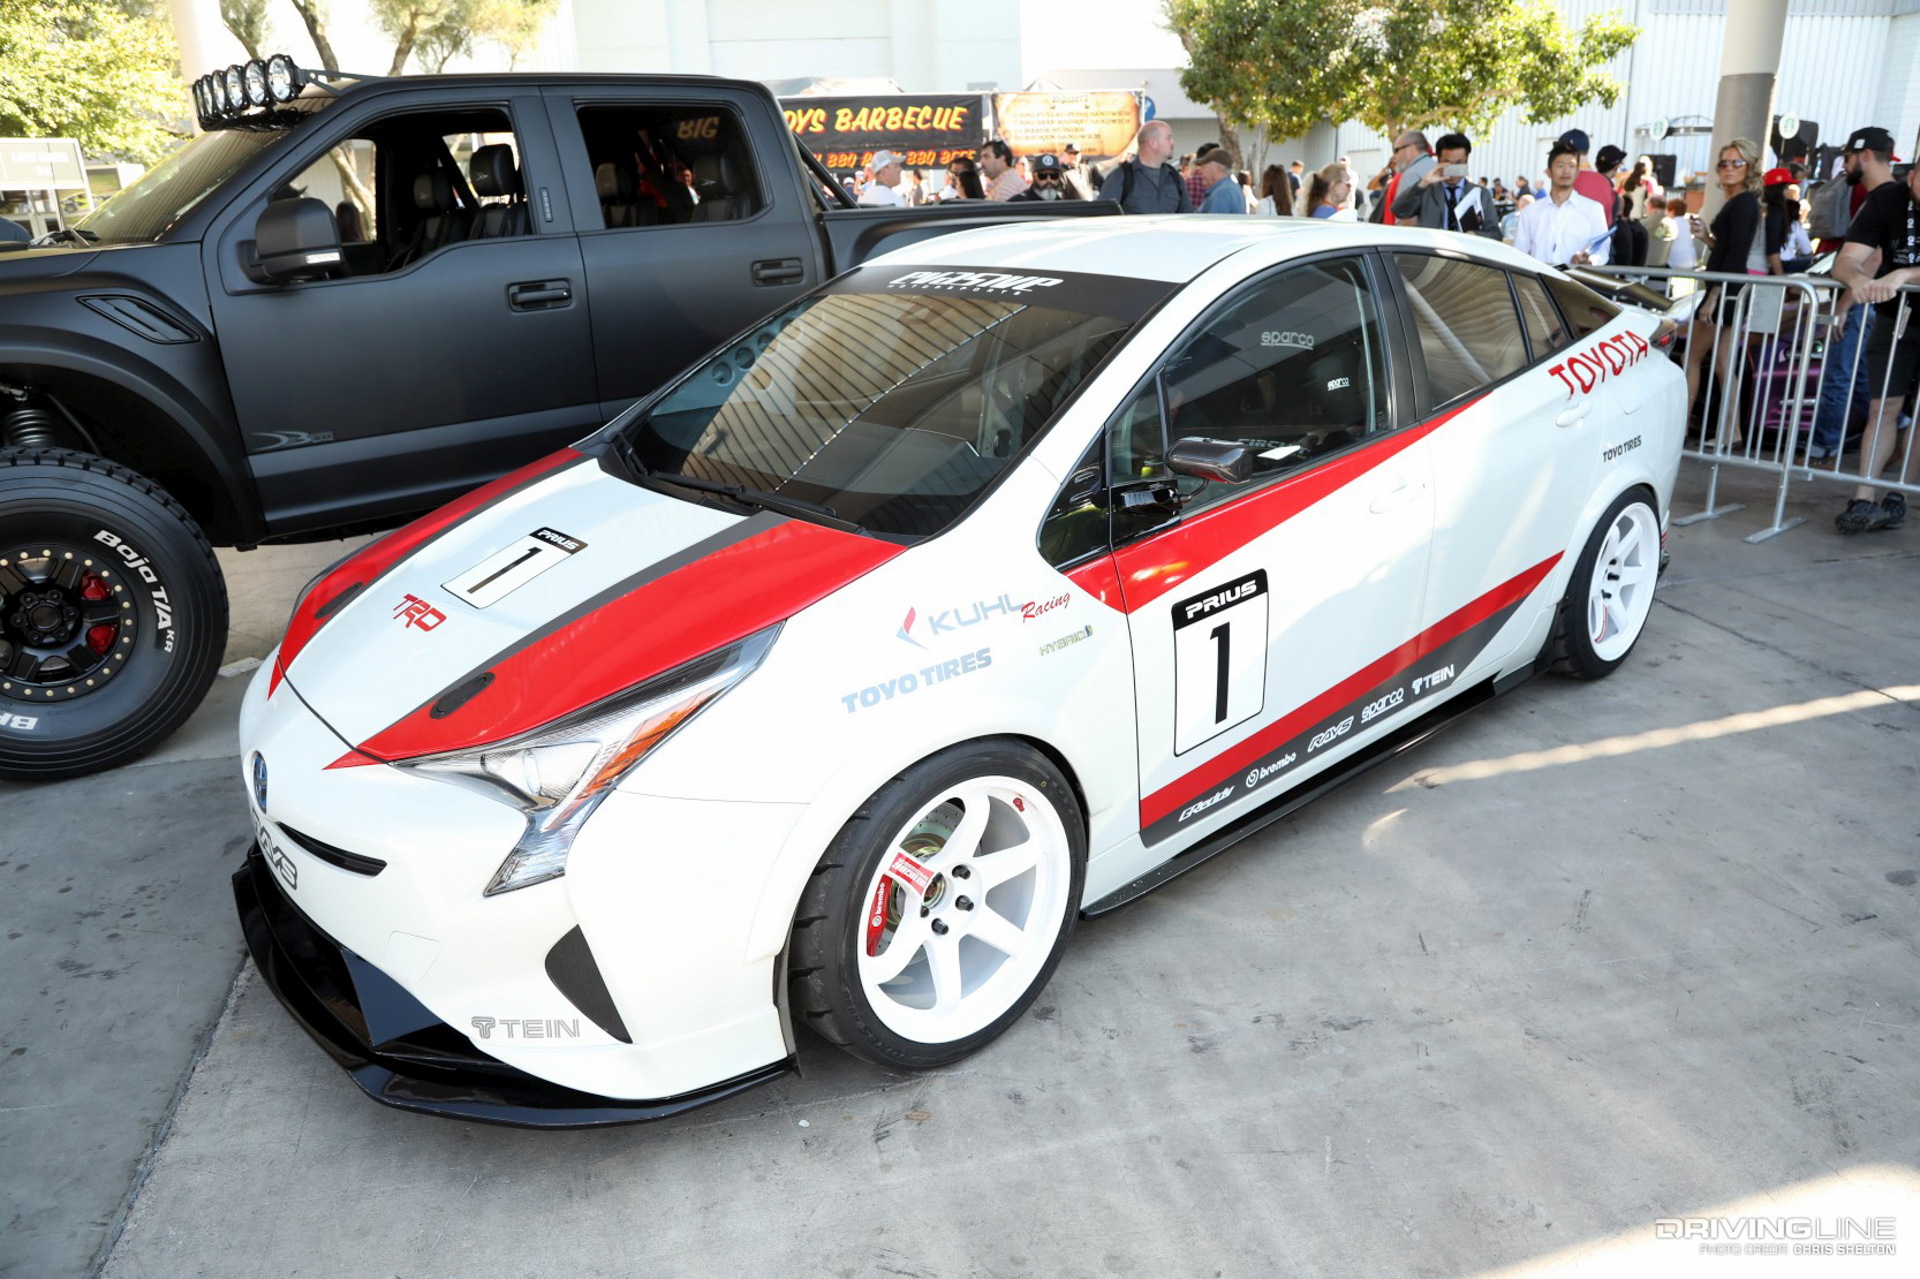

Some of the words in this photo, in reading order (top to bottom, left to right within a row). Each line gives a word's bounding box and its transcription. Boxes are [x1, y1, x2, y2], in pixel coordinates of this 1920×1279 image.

[677, 116, 720, 139] BIG
[783, 107, 828, 136] OYS
[834, 105, 970, 133] BARBECUE
[1261, 331, 1315, 350] sparco
[1548, 330, 1648, 401] TOYOTA
[1327, 377, 1350, 391] sparco
[1603, 442, 1623, 462] TOYO
[1623, 435, 1642, 454] TIRES
[537, 529, 579, 550] PRIUS
[93, 530, 158, 583] Baja
[151, 585, 172, 630] T/A
[466, 546, 543, 594] 1
[393, 593, 447, 632] TRD
[928, 593, 1025, 635] KUHL
[1021, 592, 1071, 623] Racing
[1185, 580, 1257, 619] PRIUS
[841, 673, 918, 714] TOYO
[919, 647, 992, 687] TIRES
[1209, 621, 1231, 725] 1
[1423, 664, 1455, 689] TEIN
[1361, 687, 1404, 723] sparco
[1307, 716, 1354, 753] RAYS
[1259, 752, 1297, 780] brembo
[499, 1019, 580, 1039] TEIN
